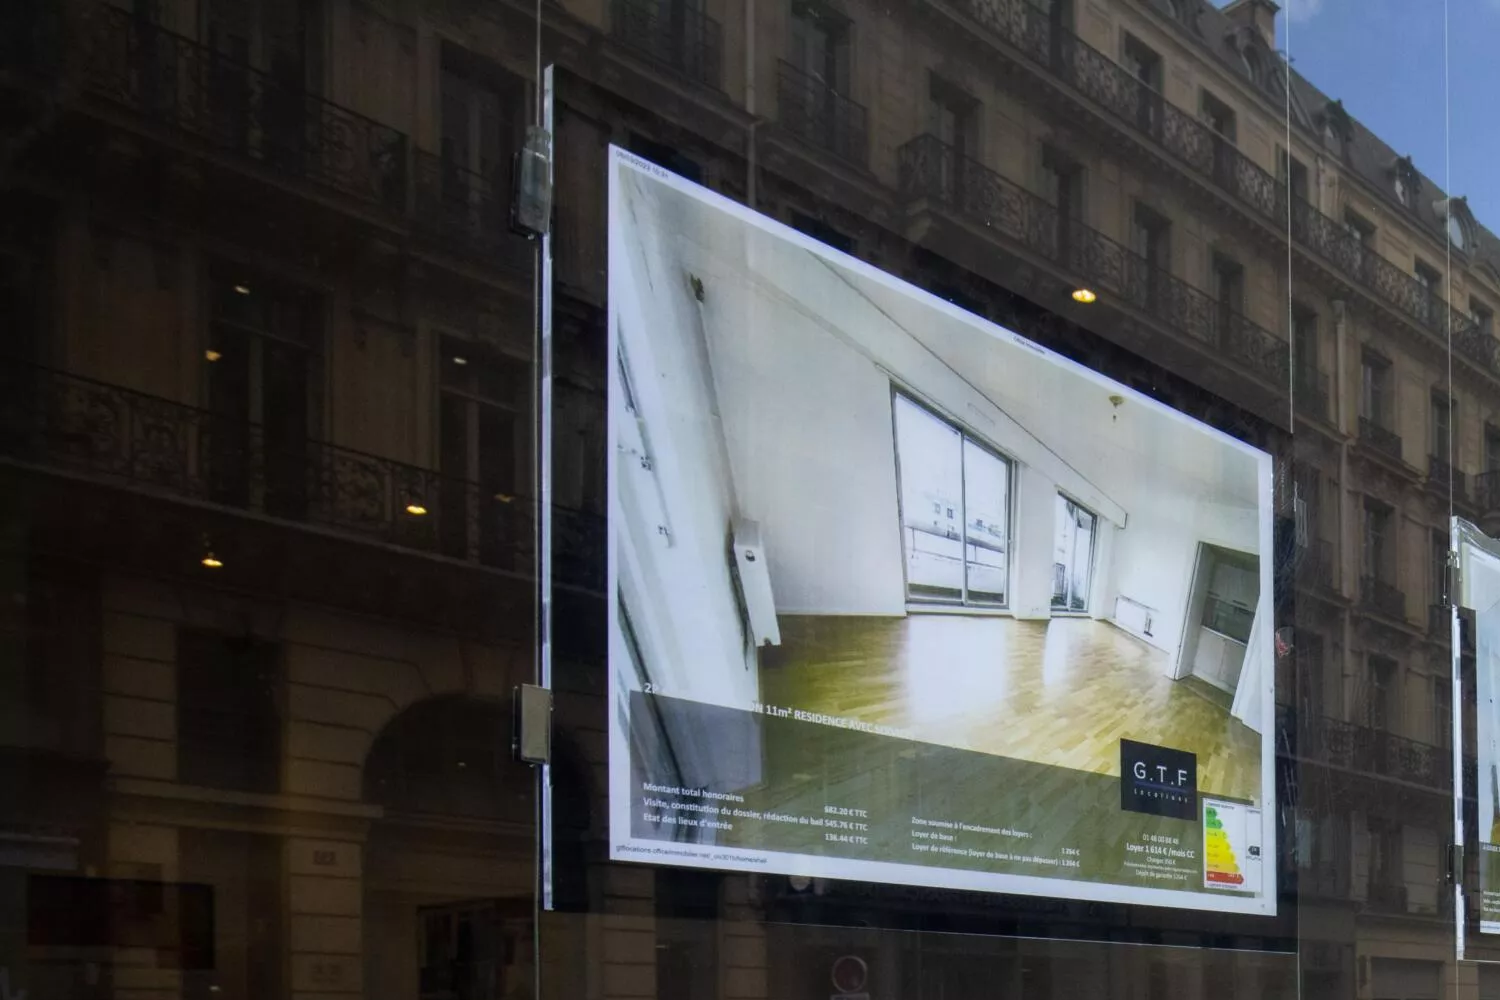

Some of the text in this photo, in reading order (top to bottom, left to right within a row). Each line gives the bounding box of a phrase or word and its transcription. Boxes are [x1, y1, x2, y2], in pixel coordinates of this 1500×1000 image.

[794, 709, 848, 729] RESIDENCE
[1133, 761, 1187, 786] G.T.F
[643, 782, 744, 803] Montant total honoraires
[643, 797, 669, 810] Visite,
[671, 801, 720, 815] constitution
[721, 806, 732, 816] du
[733, 807, 762, 821] dossier,
[763, 810, 798, 824] rédaction
[799, 815, 809, 825] du
[855, 823, 868, 831] TTC
[855, 809, 868, 818] TTC
[643, 812, 733, 831] Etat des lieux d'entrée
[855, 836, 868, 844] TTC
[912, 830, 929, 840] Loyer
[912, 843, 929, 852] Loyer
[1126, 843, 1144, 853] Loyer
